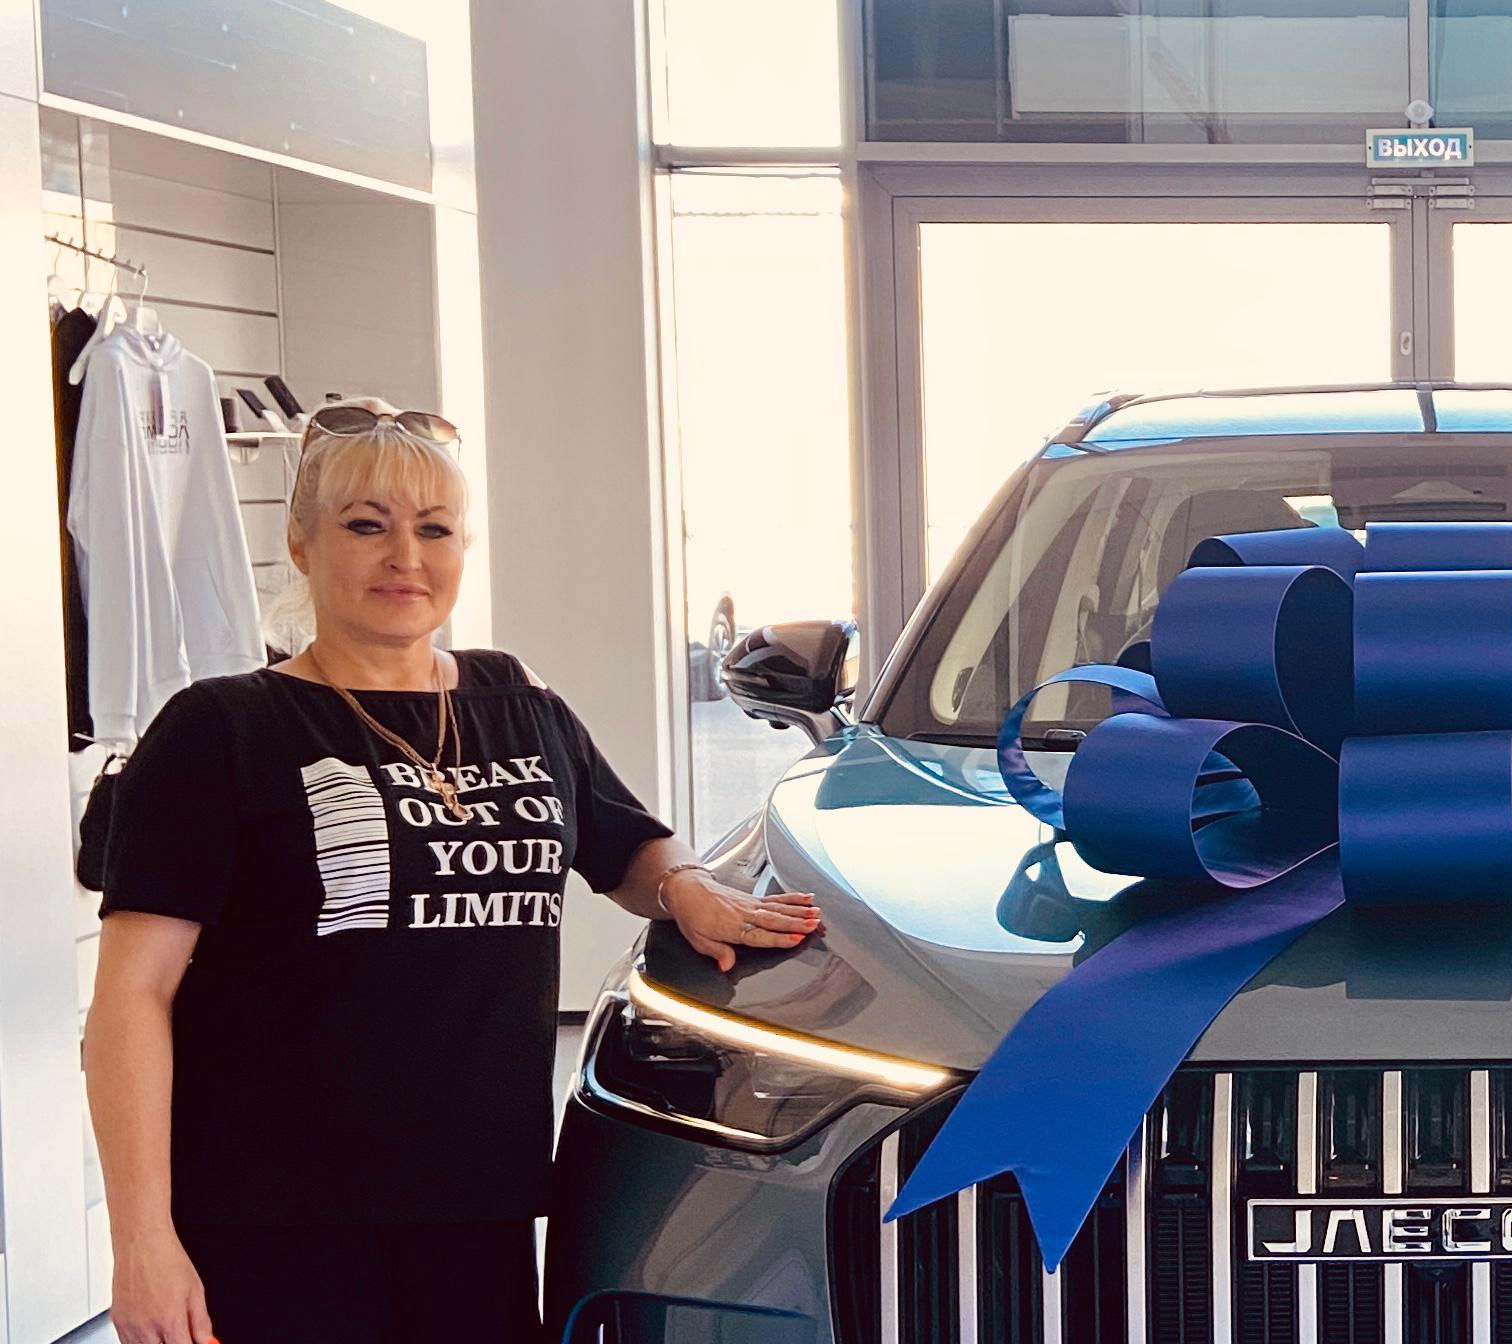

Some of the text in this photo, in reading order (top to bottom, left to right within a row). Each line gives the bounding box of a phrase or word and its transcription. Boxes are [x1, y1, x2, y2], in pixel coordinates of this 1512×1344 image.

[1376, 137, 1463, 160] ВЫХОД
[398, 795, 565, 828] OUT OF
[428, 838, 563, 876] YOUR
[407, 891, 562, 929] LIMITS
